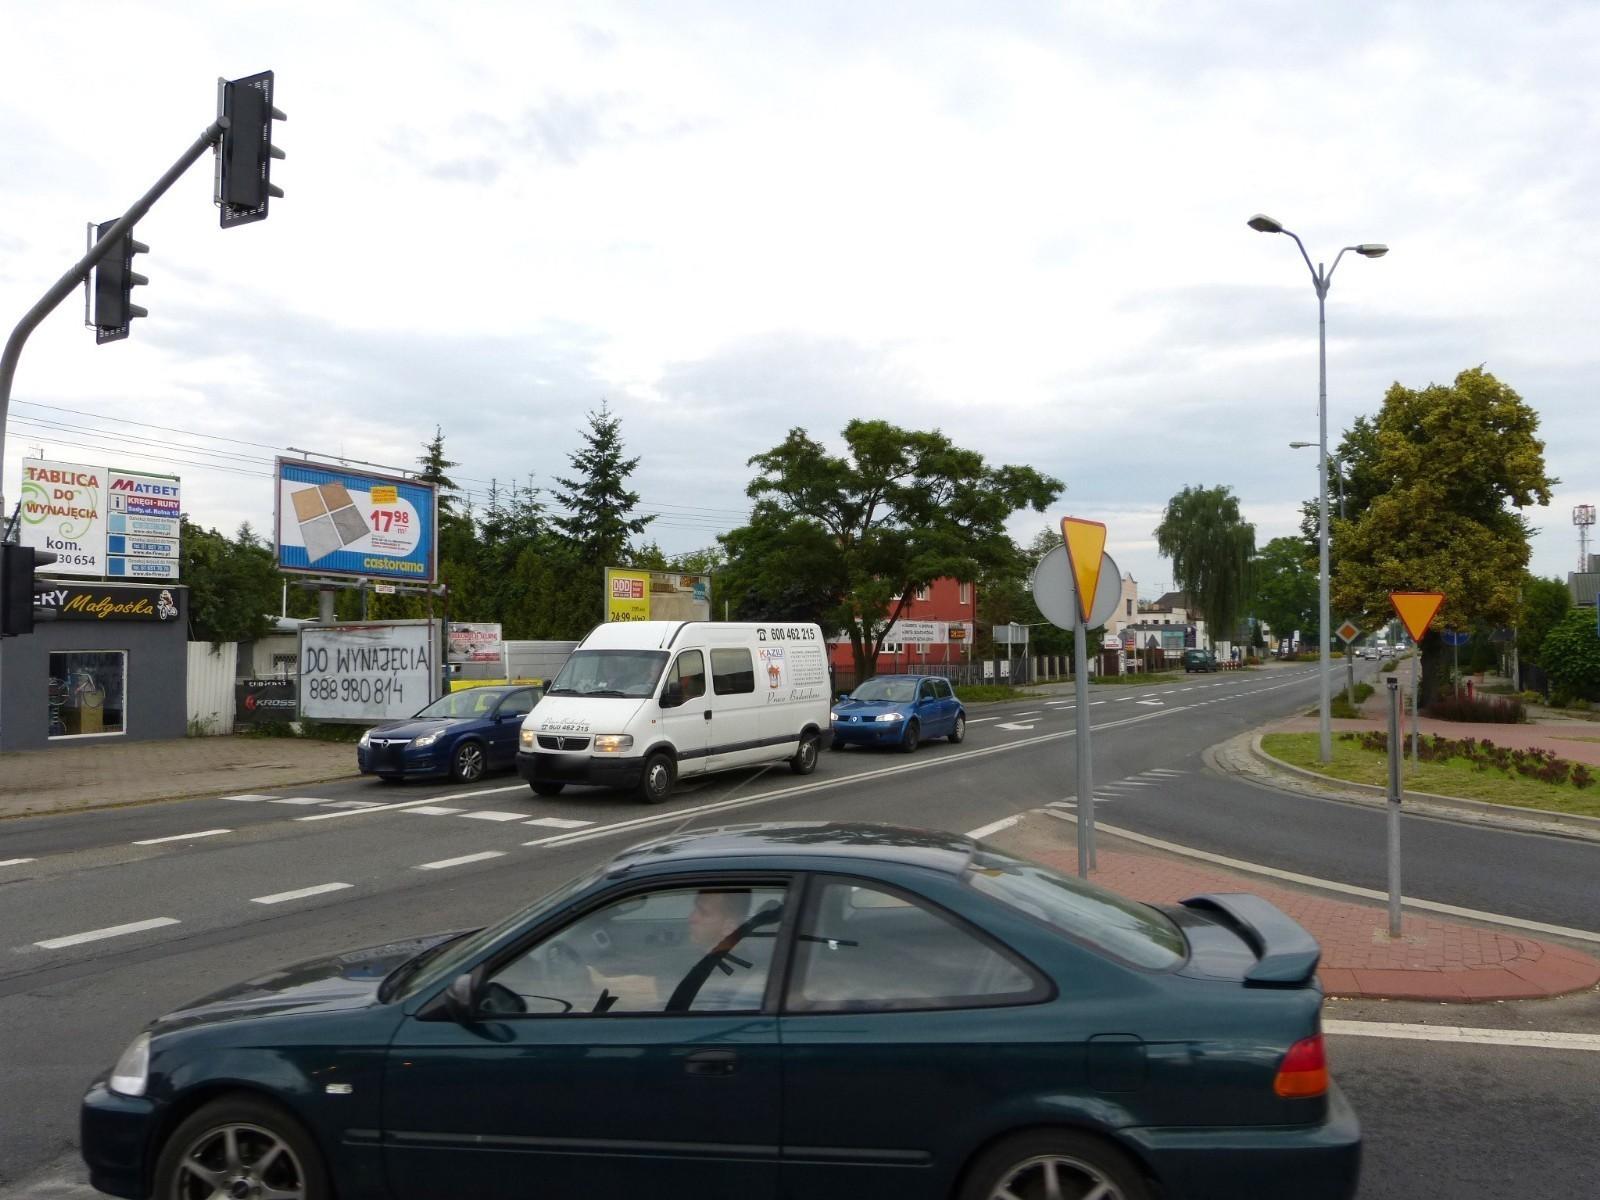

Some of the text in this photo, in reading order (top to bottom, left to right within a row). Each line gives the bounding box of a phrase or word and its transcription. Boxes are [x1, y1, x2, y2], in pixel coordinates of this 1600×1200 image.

[27, 467, 99, 488] TABLICA
[53, 489, 74, 500] DO
[110, 478, 179, 496] MATBET
[26, 503, 98, 520] WYNAJĘCIA
[46, 536, 82, 551] kom.
[74, 555, 96, 566] 654
[363, 557, 424, 573] castorama
[64, 594, 153, 618] Małgośka
[771, 628, 815, 641] 600 462 215
[305, 646, 429, 676] DO WYNAJĘCIA
[310, 676, 403, 705] 888 980 814
